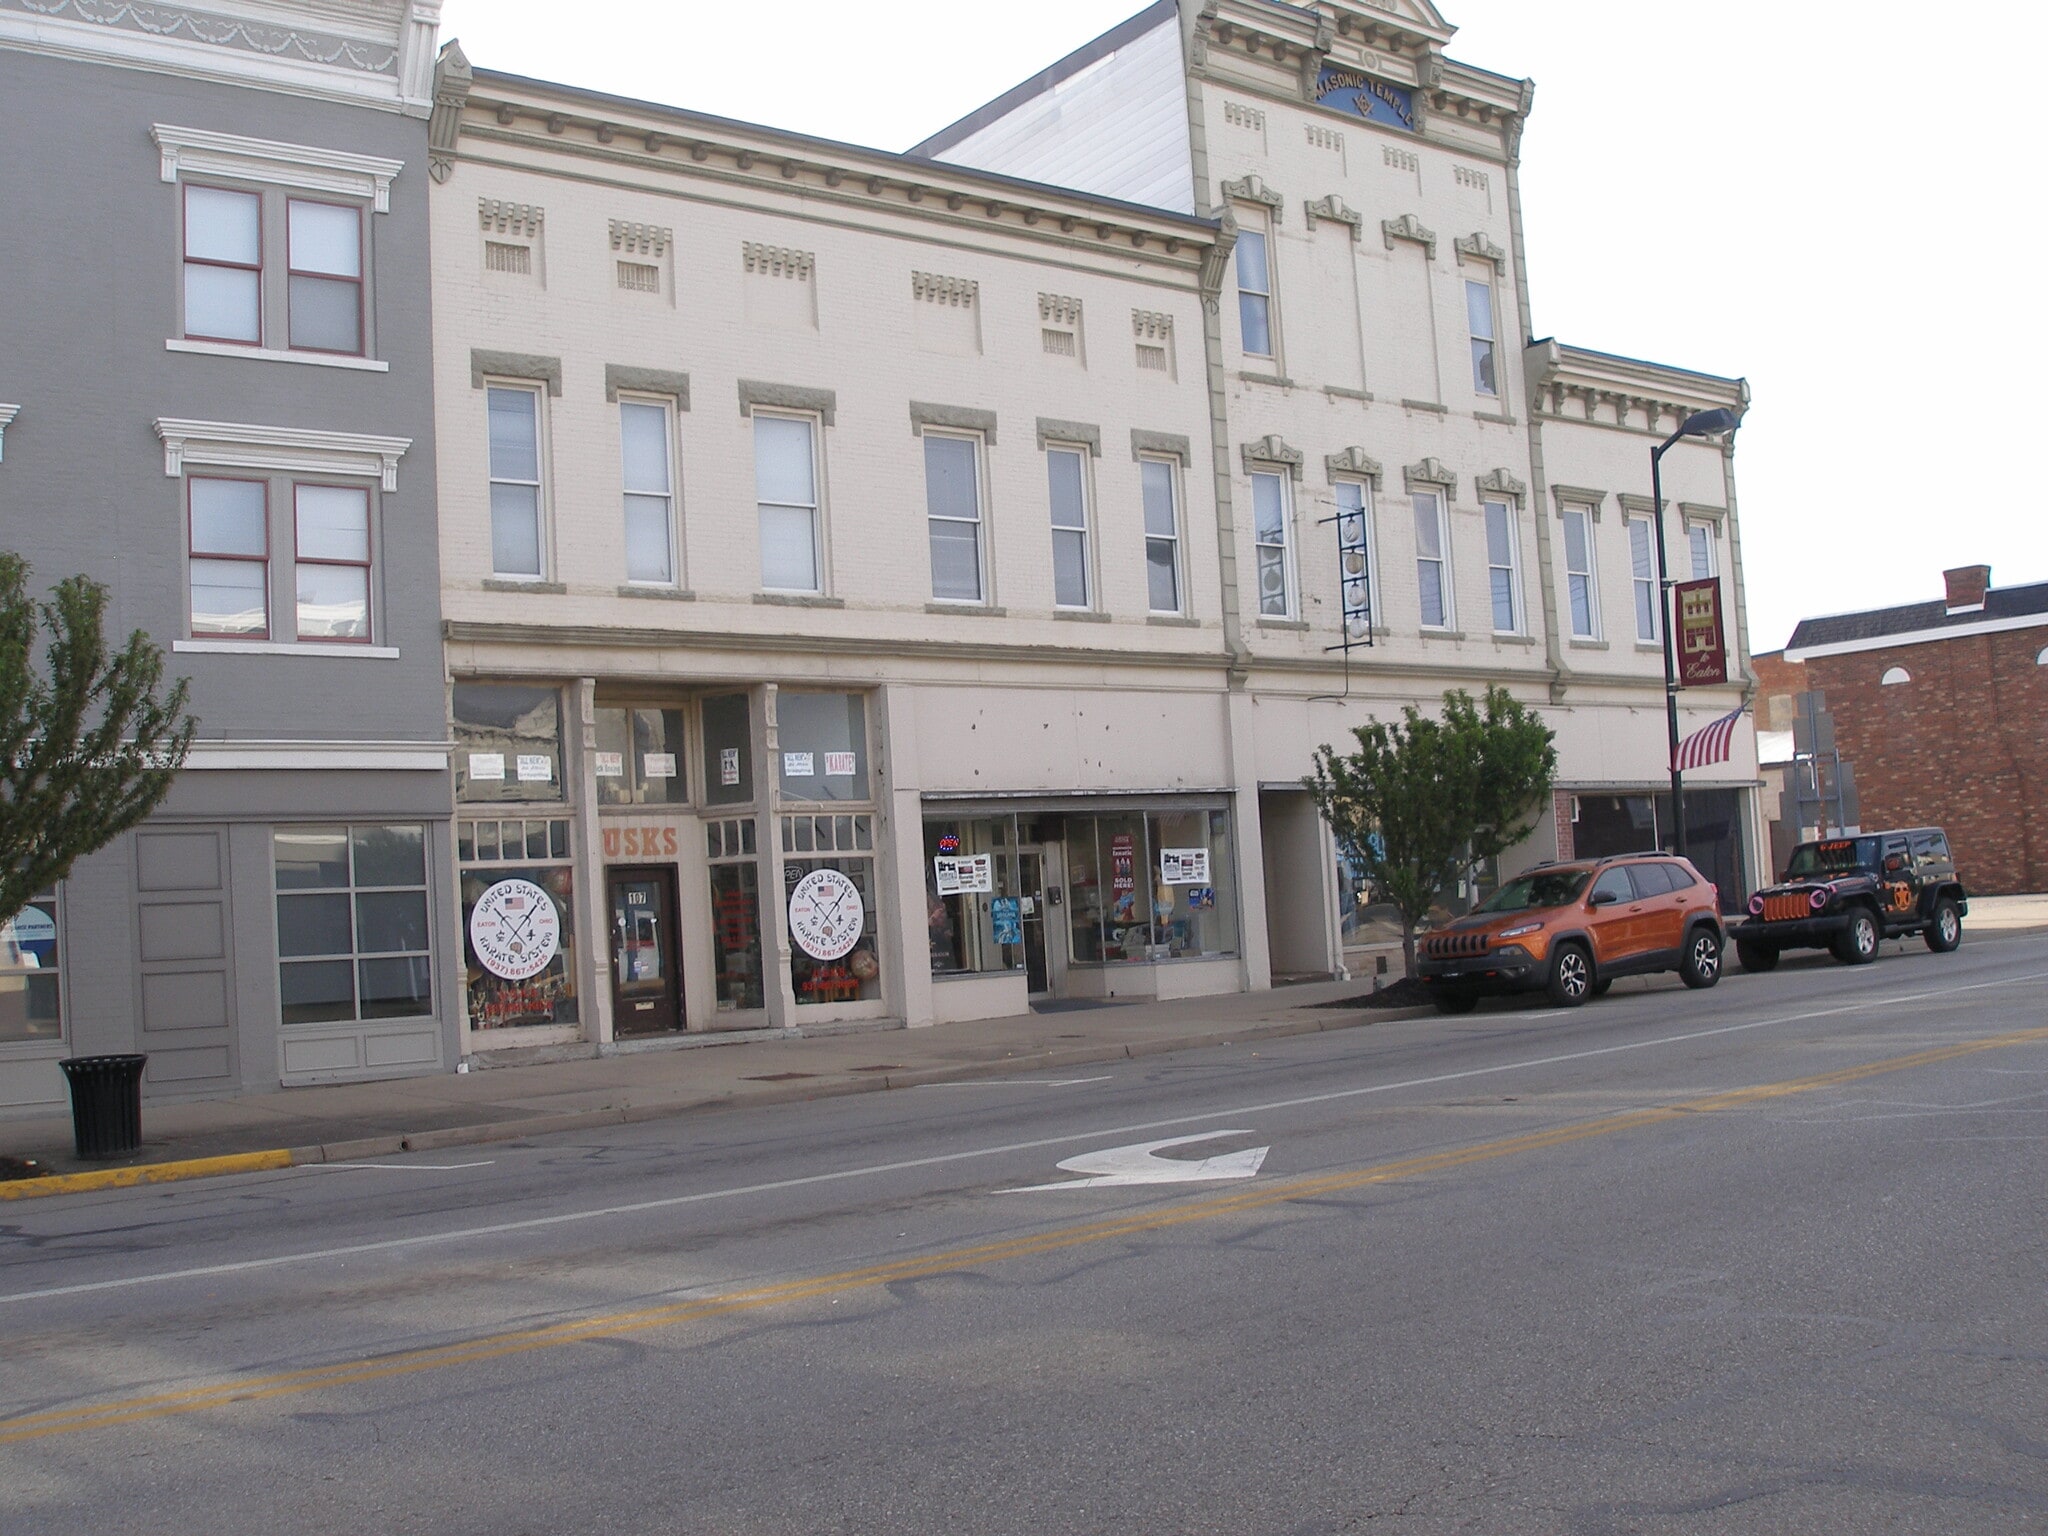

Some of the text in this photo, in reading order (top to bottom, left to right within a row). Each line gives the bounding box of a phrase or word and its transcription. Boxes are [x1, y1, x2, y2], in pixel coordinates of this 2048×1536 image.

[1316, 73, 1414, 126] MASONIC TEMPLE
[1686, 663, 1720, 679] Eaton
[602, 827, 678, 857] USKS
[480, 884, 549, 913] UNITED STATES
[629, 892, 647, 904] 107
[797, 874, 854, 899] UNITED STATES
[797, 921, 827, 946] KARATE
[830, 917, 858, 945] SYSTEM
[480, 931, 553, 964] KARATE SYSTEM
